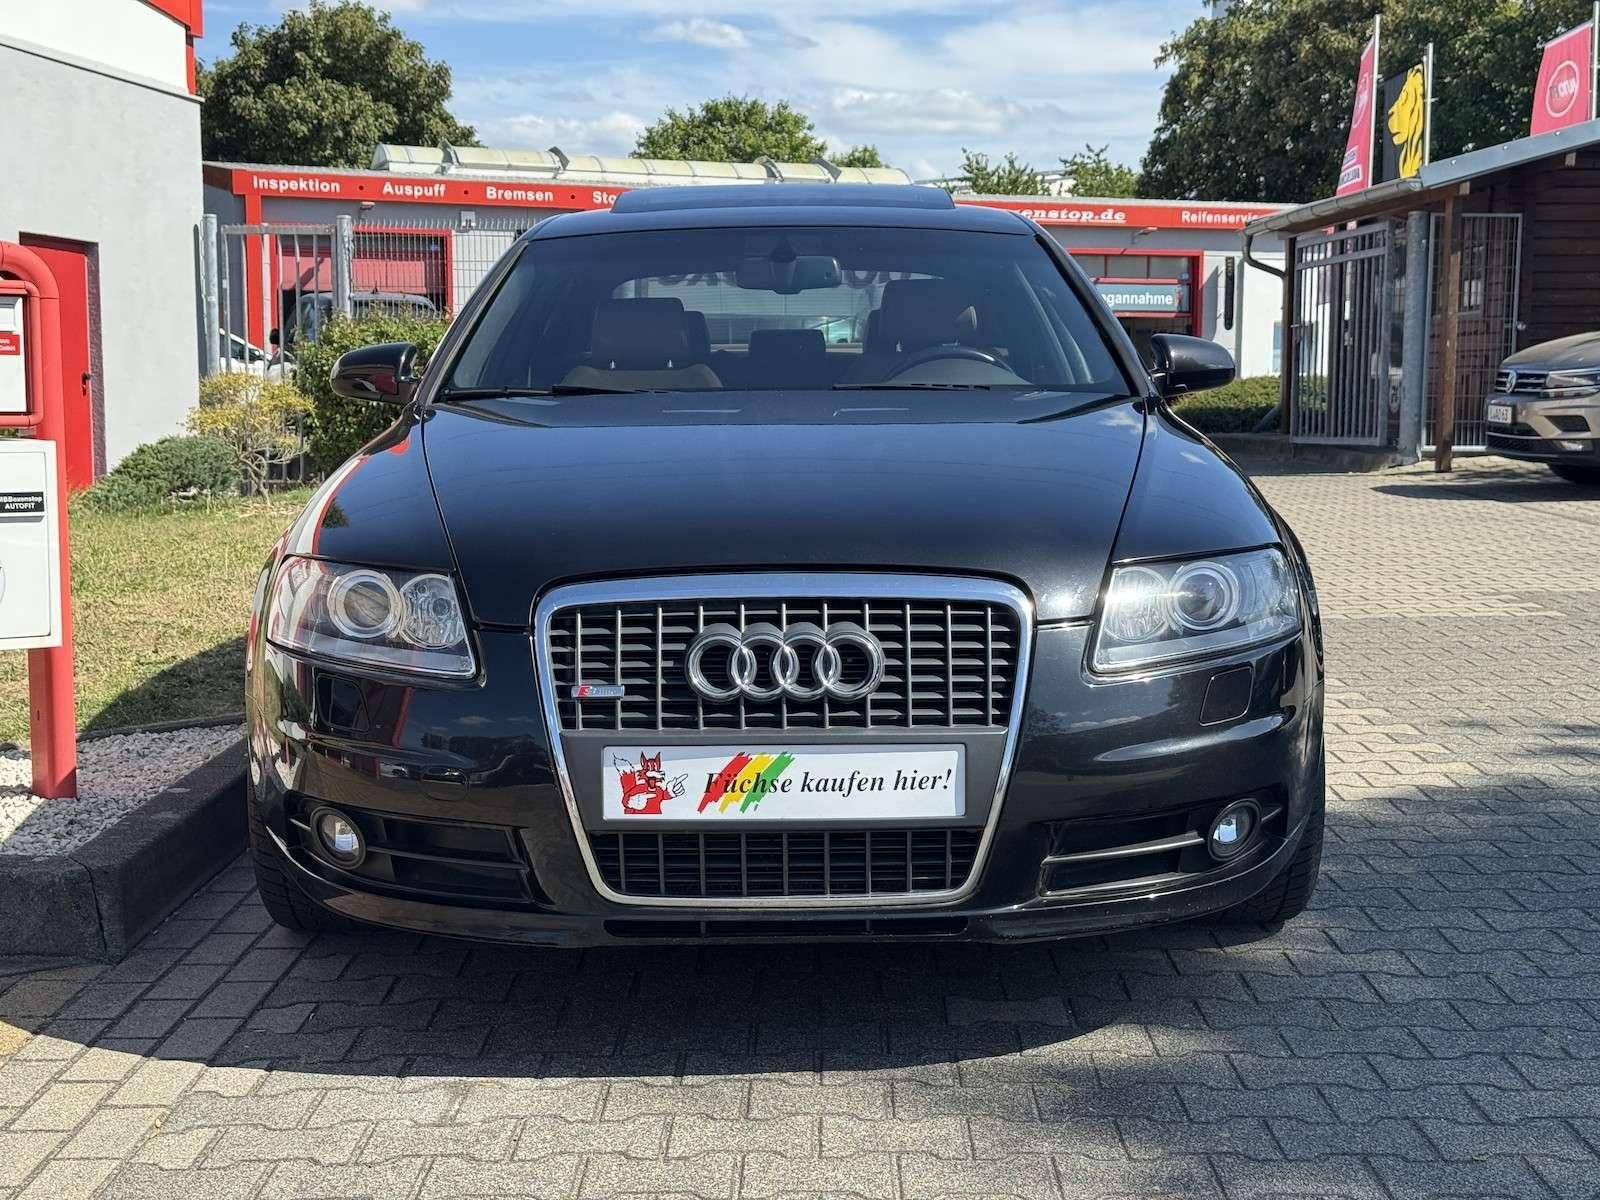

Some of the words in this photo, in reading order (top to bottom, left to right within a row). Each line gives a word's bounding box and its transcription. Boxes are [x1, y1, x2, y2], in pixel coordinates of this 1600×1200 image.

[253, 175, 340, 192] Inspektion
[382, 181, 446, 199] Auspuff
[486, 186, 553, 201] Bremsen
[1017, 208, 1127, 223] enstop.de
[704, 771, 791, 794] Füchse
[801, 771, 884, 797] kaufen
[892, 767, 952, 791] hier!
